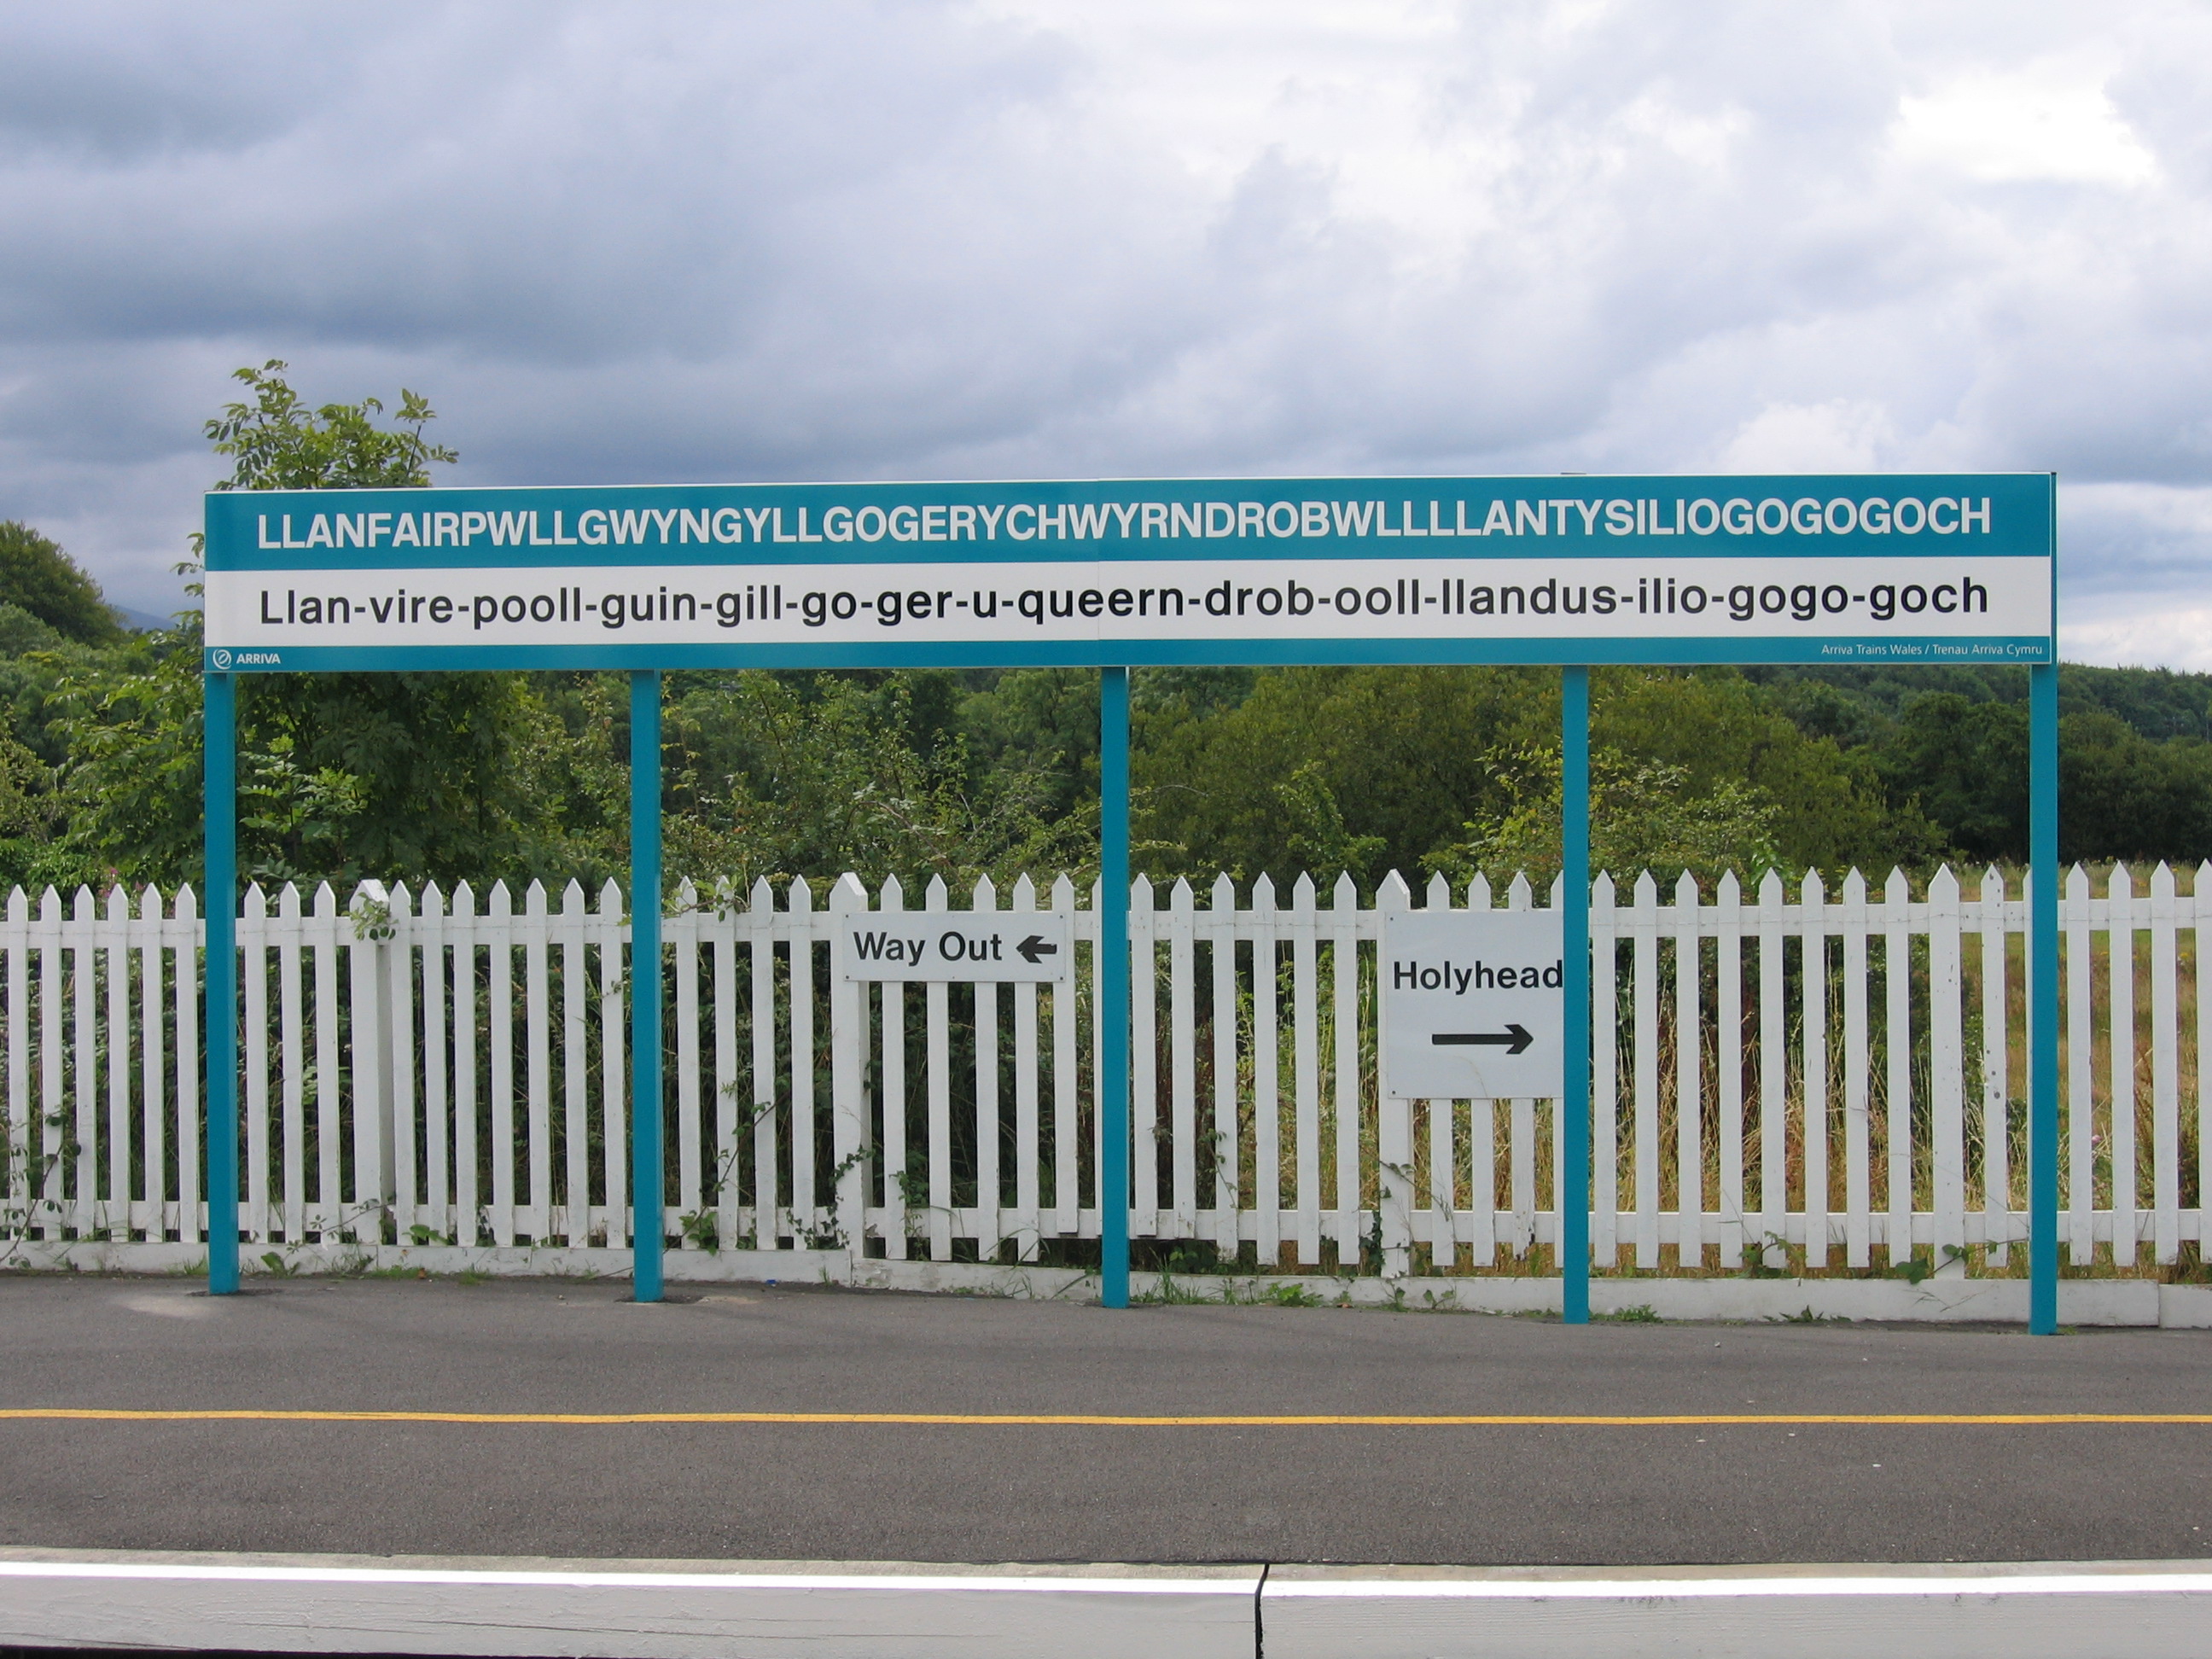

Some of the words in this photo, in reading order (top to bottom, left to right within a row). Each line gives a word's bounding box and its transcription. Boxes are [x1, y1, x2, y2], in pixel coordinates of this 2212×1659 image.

[258, 497, 1991, 550] LLANFAIRPWLLGWYNGYLLGOGERYCHWYRNDROBWLLLLANTYSILIOGOGOGOCH
[260, 576, 1988, 630] Llan-vire-pooll-guin-gill-go-ger-u-queern-drob-ooll-llandus-ilio-gogo-goch
[236, 653, 281, 664] ARRIVA
[1821, 643, 1853, 655] Arriva
[1857, 643, 1887, 655] Trains
[1889, 643, 1922, 655] Wales
[1933, 643, 1968, 655] Trenau
[1971, 643, 2003, 655] Arriva
[2006, 643, 2043, 657] Cymru
[853, 931, 926, 966] Way
[939, 931, 1003, 961] Out
[1394, 959, 1563, 995] Holyhead
